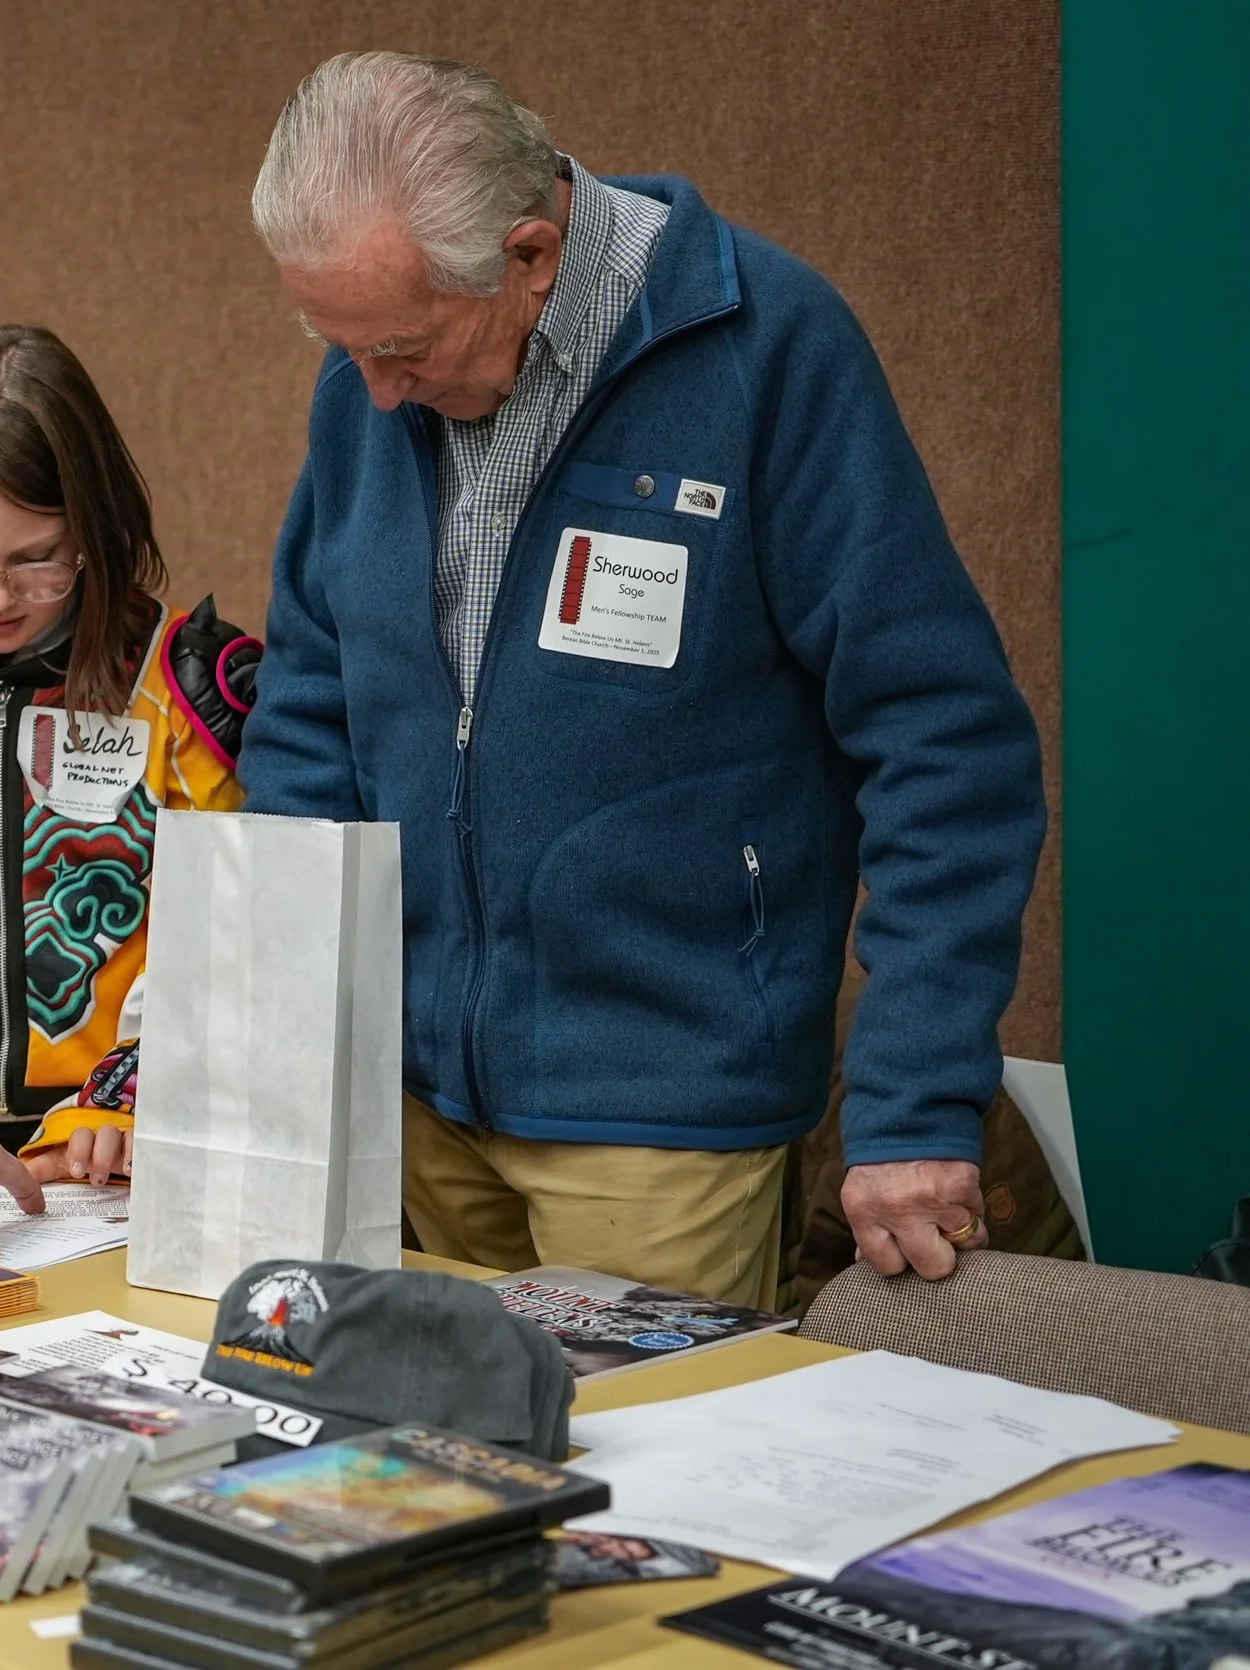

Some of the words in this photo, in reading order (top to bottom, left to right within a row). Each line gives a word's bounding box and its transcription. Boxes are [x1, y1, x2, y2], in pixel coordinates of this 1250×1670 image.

[592, 555, 679, 585] Sherwood
[618, 584, 645, 599] Sage
[591, 605, 610, 615] Men's
[611, 608, 646, 621] Fellowship
[646, 614, 667, 623] TEAM
[67, 771, 129, 787] PRODUCTIONS
[498, 1280, 625, 1314] MOUNT
[1054, 1523, 1233, 1576] FIRE
[777, 1588, 972, 1656] MOUNT
